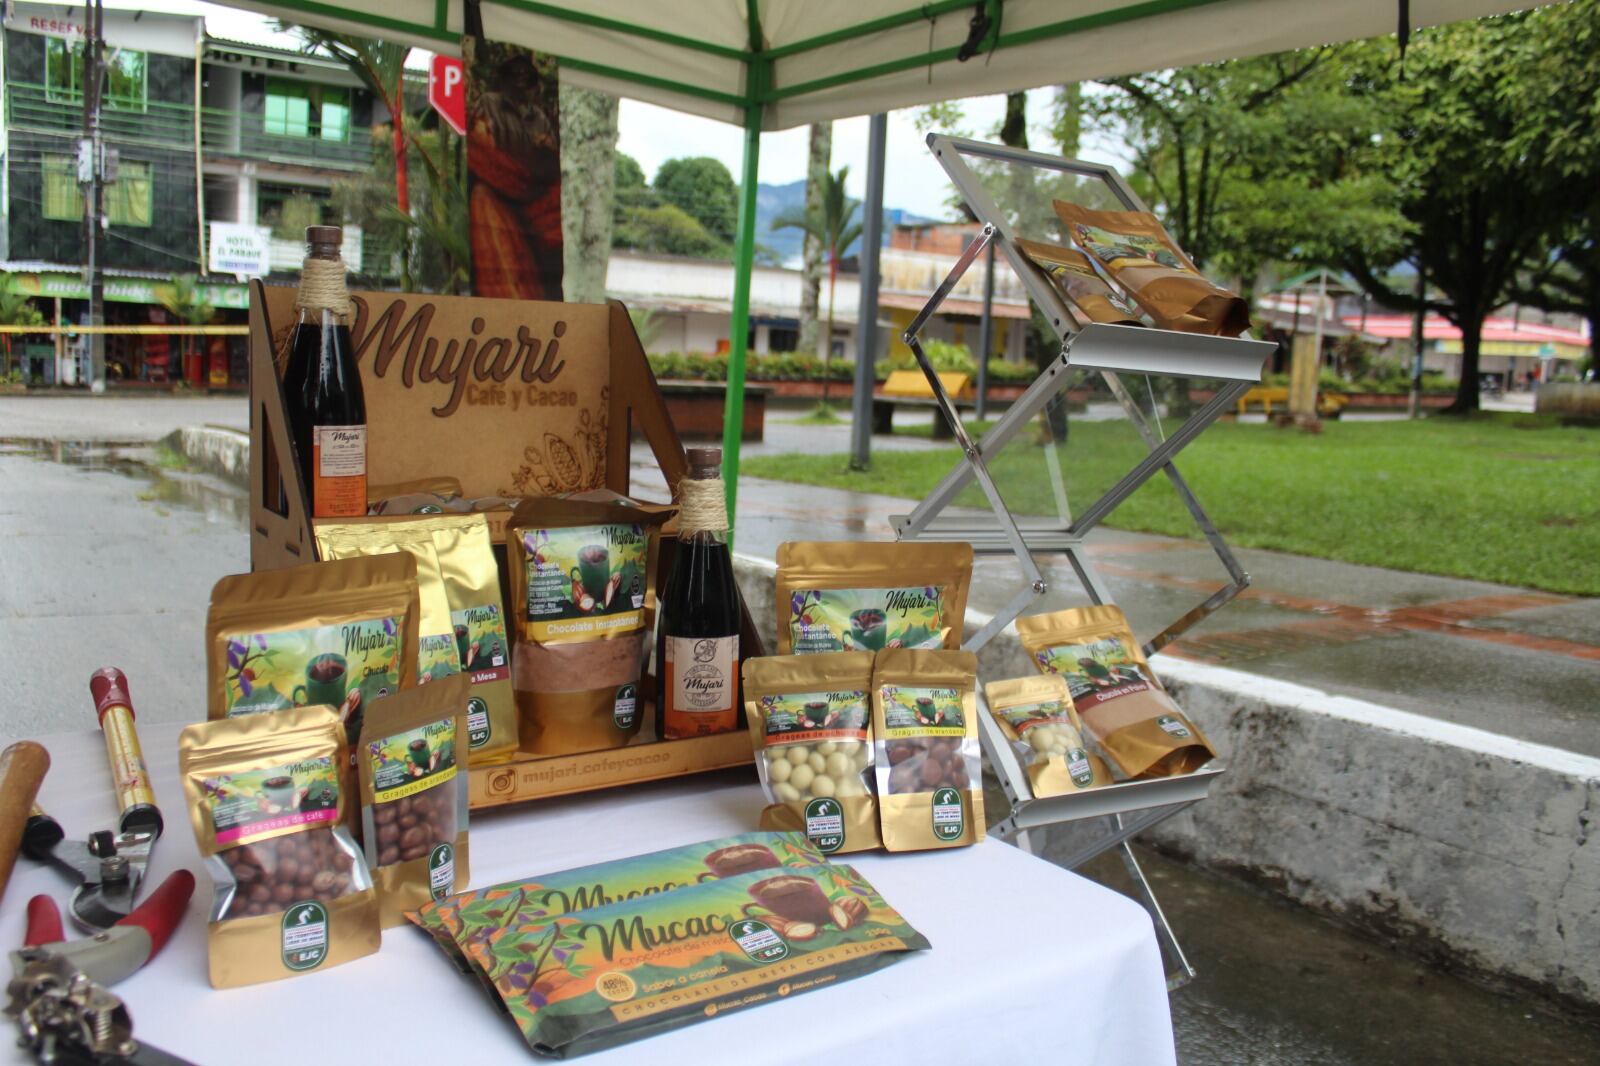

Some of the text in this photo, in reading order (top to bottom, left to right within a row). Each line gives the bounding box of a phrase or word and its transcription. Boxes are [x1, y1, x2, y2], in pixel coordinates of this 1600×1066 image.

[349, 295, 567, 418] Mujari
[466, 383, 578, 411] Café y Cacao
[884, 589, 927, 619] Mujari
[464, 609, 492, 629] Mujari
[547, 622, 593, 634] Chocolate
[342, 625, 386, 662] Mujari
[476, 672, 498, 683] Mesa
[683, 678, 724, 694] Mujari
[825, 691, 856, 704] Mujari
[285, 761, 324, 777] Mujari
[523, 751, 671, 783] mujari.cafeycacao
[944, 826, 958, 834] EJC
[820, 837, 838, 845] EJC
[300, 950, 320, 961] EJC
[764, 947, 784, 957] EJC
[622, 984, 720, 1015] CHOCOLATE
[730, 976, 749, 988] DE
[758, 963, 797, 980] MESA
[806, 950, 836, 967] CON
